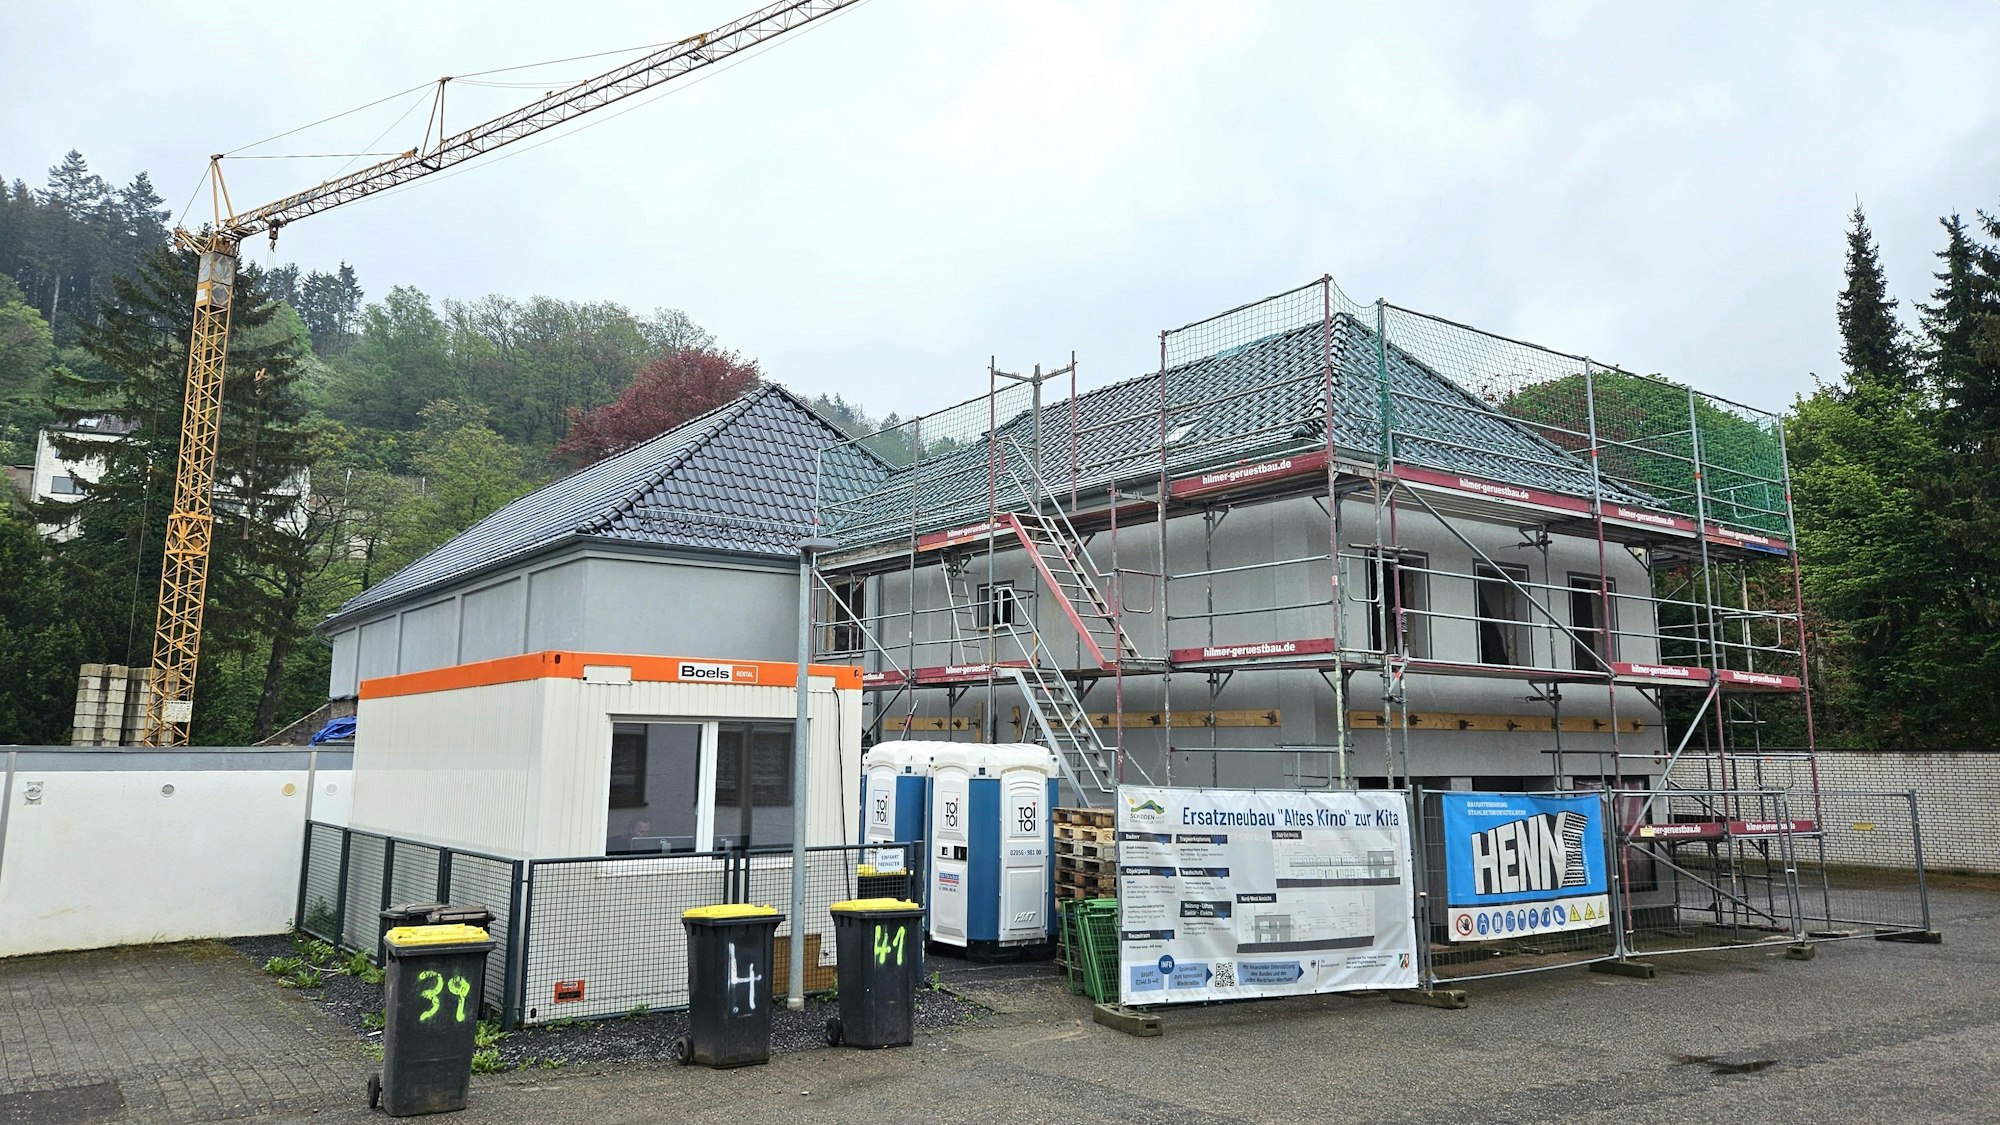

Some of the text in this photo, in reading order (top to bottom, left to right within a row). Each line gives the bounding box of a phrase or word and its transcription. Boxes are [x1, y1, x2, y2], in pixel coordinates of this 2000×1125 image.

[1202, 460, 1292, 485] hilmer-geruestbau.de
[1460, 478, 1529, 500] hilmer-geruestbau.de
[1618, 508, 1674, 526] hilmer-geruestbau.de
[1204, 642, 1296, 658] hilmer-geruestbau.de
[682, 665, 730, 680] Boels
[1632, 664, 1688, 676] hilmer-geruestbau.de
[1018, 820, 1036, 832] TOI
[1182, 807, 1399, 827] Ersatzneubau "Altes Kino" zur Kita
[1471, 811, 1568, 895] HENN
[873, 925, 906, 965] 41
[419, 970, 471, 1022] 39
